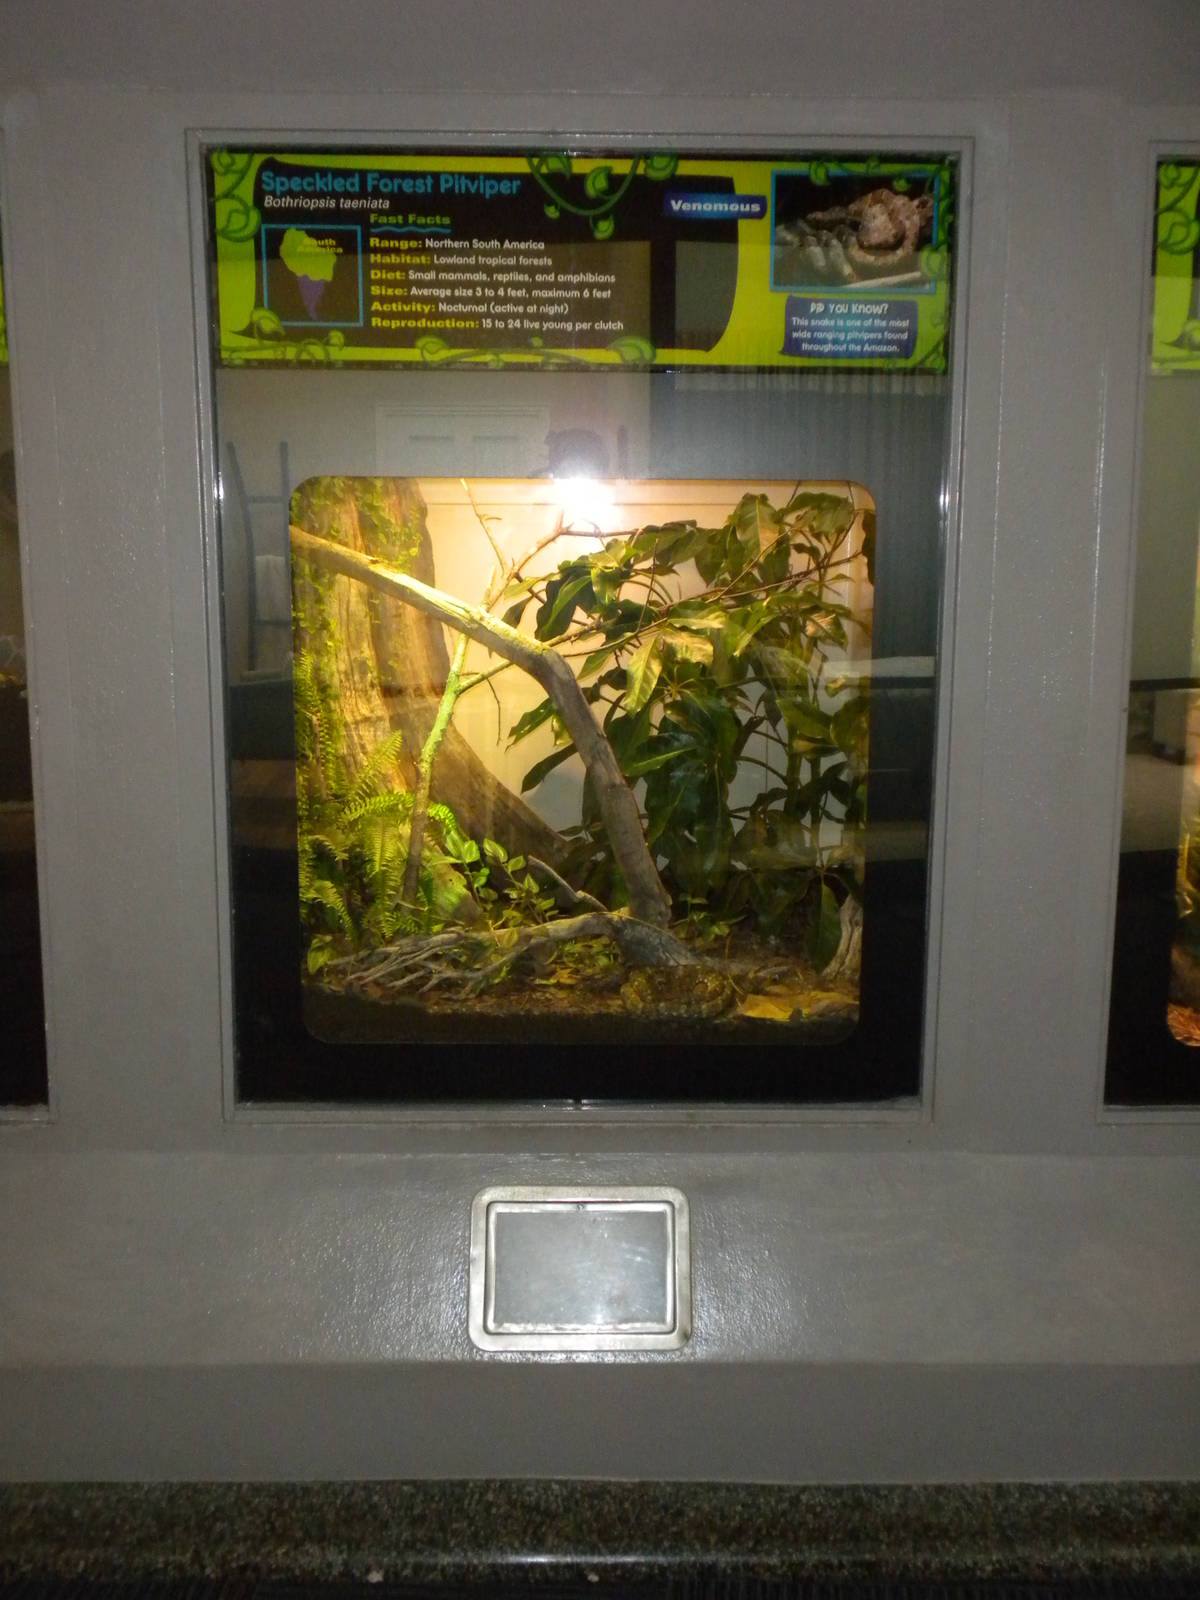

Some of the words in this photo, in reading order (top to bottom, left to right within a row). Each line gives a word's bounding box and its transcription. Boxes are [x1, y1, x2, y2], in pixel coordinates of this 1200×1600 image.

[262, 171, 360, 195] Speckled
[367, 173, 433, 193] Forest
[440, 174, 521, 199] Pitviper
[264, 195, 336, 210] Bothriopsis
[340, 196, 390, 209] taeniata
[670, 199, 761, 212] Venomous
[370, 213, 403, 224] Fast
[408, 214, 451, 225] Facts
[369, 237, 422, 249] Range:
[425, 238, 469, 249] Northern
[472, 239, 501, 249] South
[503, 239, 545, 250] America
[370, 253, 431, 264] Habitat:
[433, 254, 476, 264] Lowland
[478, 255, 517, 267] tropical
[519, 255, 553, 266] forests
[370, 269, 406, 280] Diet:
[408, 269, 436, 280] Small
[438, 271, 490, 282] mammals,
[493, 271, 533, 283] reptiles,
[535, 272, 555, 282] and
[557, 272, 616, 285] amphibians
[370, 285, 408, 296] Size:
[410, 286, 452, 298] Average
[454, 286, 473, 297] size
[485, 287, 495, 297] to
[497, 287, 505, 297] 4
[507, 287, 529, 299] feet,
[531, 287, 581, 299] maximum
[582, 288, 590, 299] 6
[592, 288, 612, 299] feet
[371, 301, 436, 314] Activity:
[438, 302, 487, 313] Nocturnal
[490, 302, 525, 314] (active
[526, 304, 538, 313] at
[539, 303, 569, 316] night)
[371, 317, 480, 329] Reproduction:
[481, 318, 493, 329] 15
[495, 319, 506, 329] to
[507, 319, 521, 329] 24
[523, 319, 540, 329] live
[542, 320, 573, 332] young
[575, 321, 592, 332] per
[594, 320, 625, 331] clutch
[792, 317, 809, 327] This
[810, 319, 835, 327] snake
[836, 319, 844, 327] is
[846, 319, 862, 327] one
[863, 318, 873, 328] of
[874, 319, 888, 328] the
[889, 319, 910, 328] most
[792, 331, 812, 339] wide
[813, 332, 846, 341] ranging
[884, 331, 909, 341] found
[802, 343, 848, 353] throughout
[849, 343, 862, 352] the
